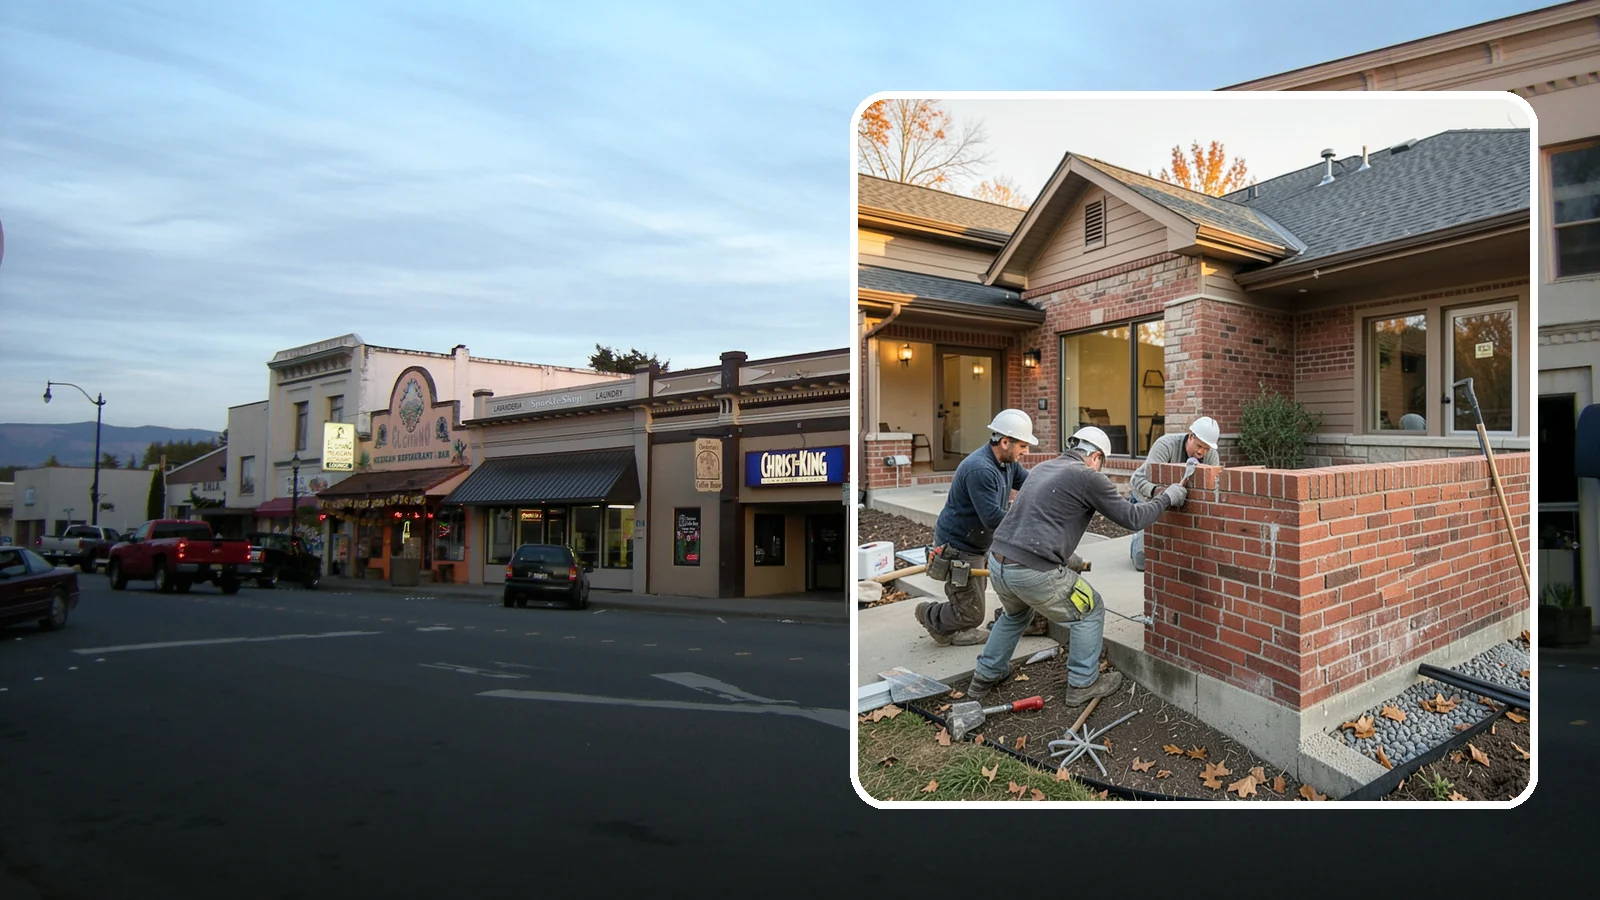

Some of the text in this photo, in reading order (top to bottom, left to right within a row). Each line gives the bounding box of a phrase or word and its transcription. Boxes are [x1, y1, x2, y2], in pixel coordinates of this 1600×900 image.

[562, 394, 583, 404] Shop
[595, 389, 624, 400] LAUNDRY
[493, 402, 523, 413] LAVANDERIA
[391, 425, 402, 449] EL
[397, 451, 433, 462] RESTAURANT
[438, 450, 450, 459] BAR
[760, 449, 828, 479] CHRIST KING
